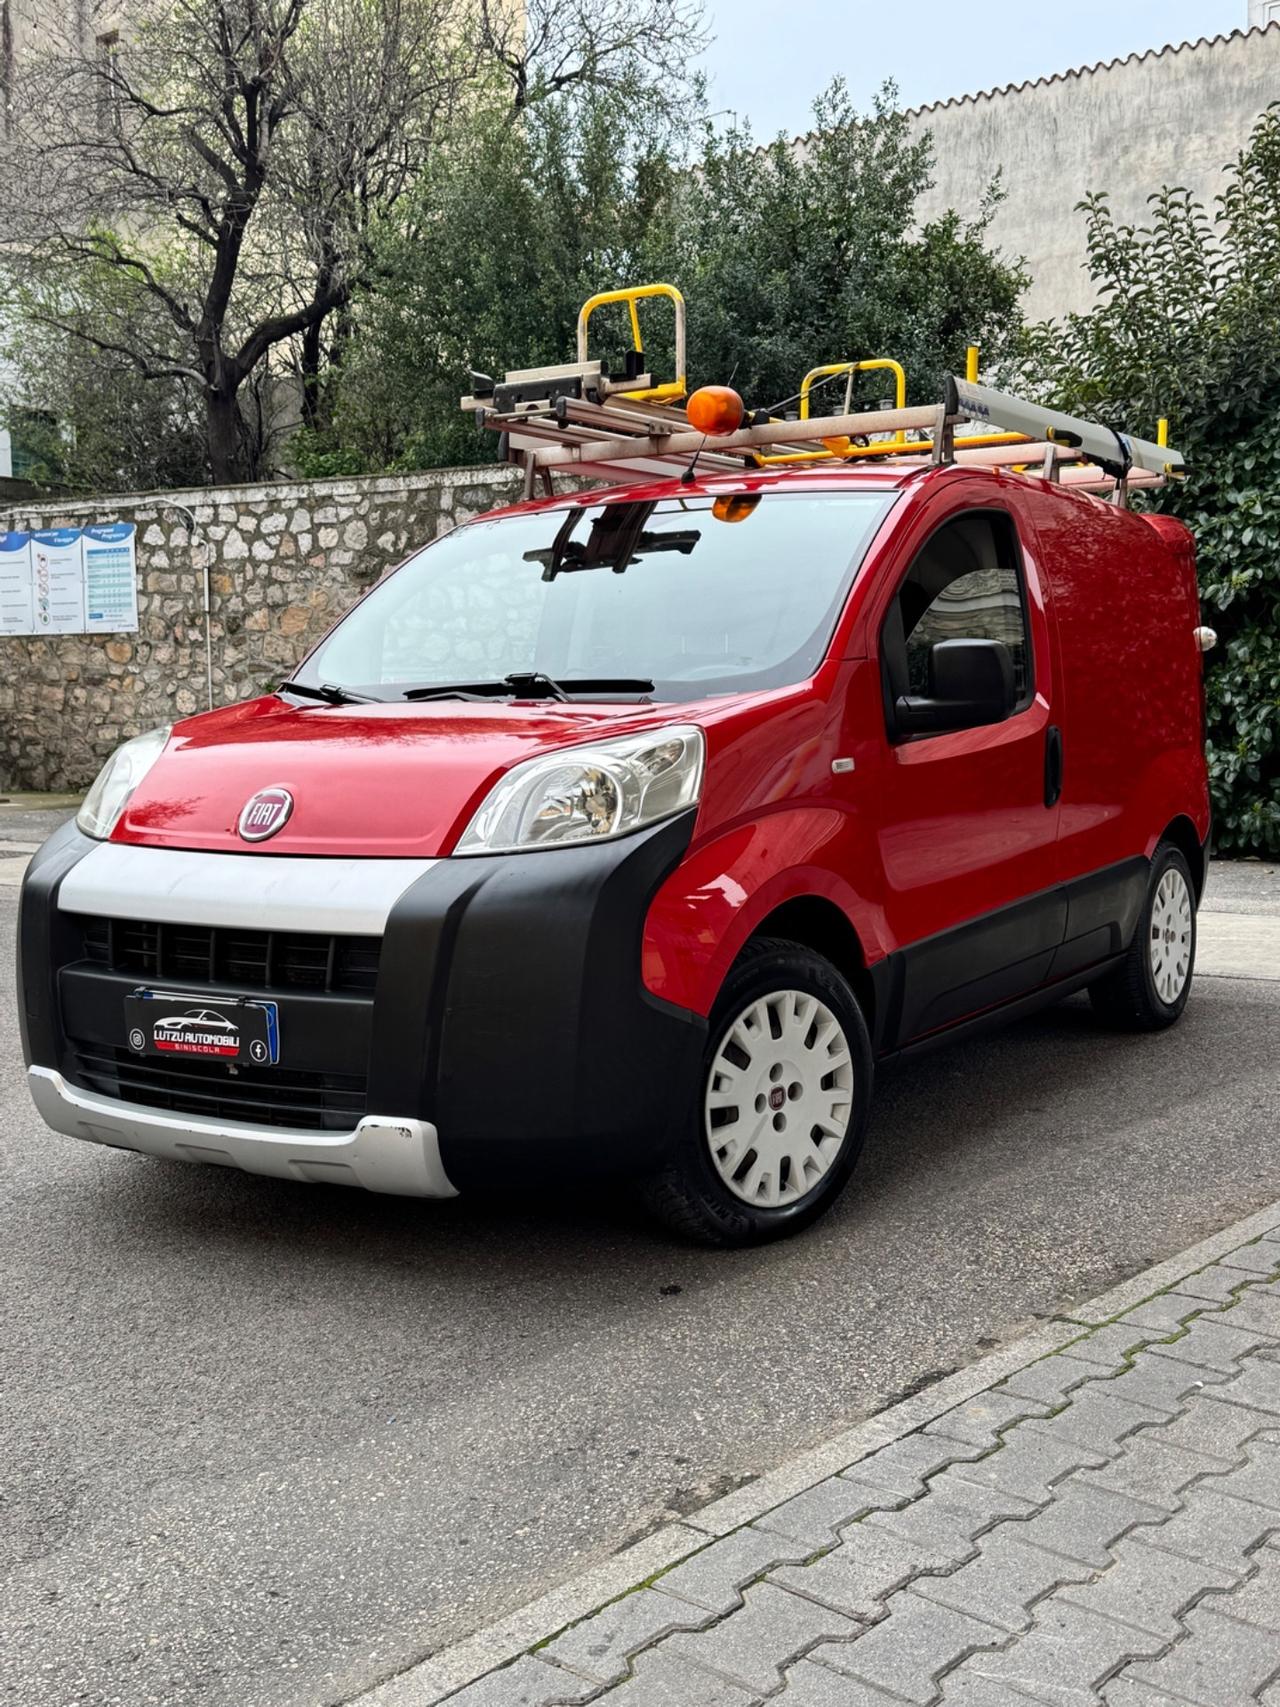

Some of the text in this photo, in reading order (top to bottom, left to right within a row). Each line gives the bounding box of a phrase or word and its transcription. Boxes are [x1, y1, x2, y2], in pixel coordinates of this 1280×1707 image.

[247, 803, 282, 825] FIAT
[153, 1030, 240, 1047] LUTZU AUTOMOBILI
[174, 1043, 221, 1054] SINISCOLA
